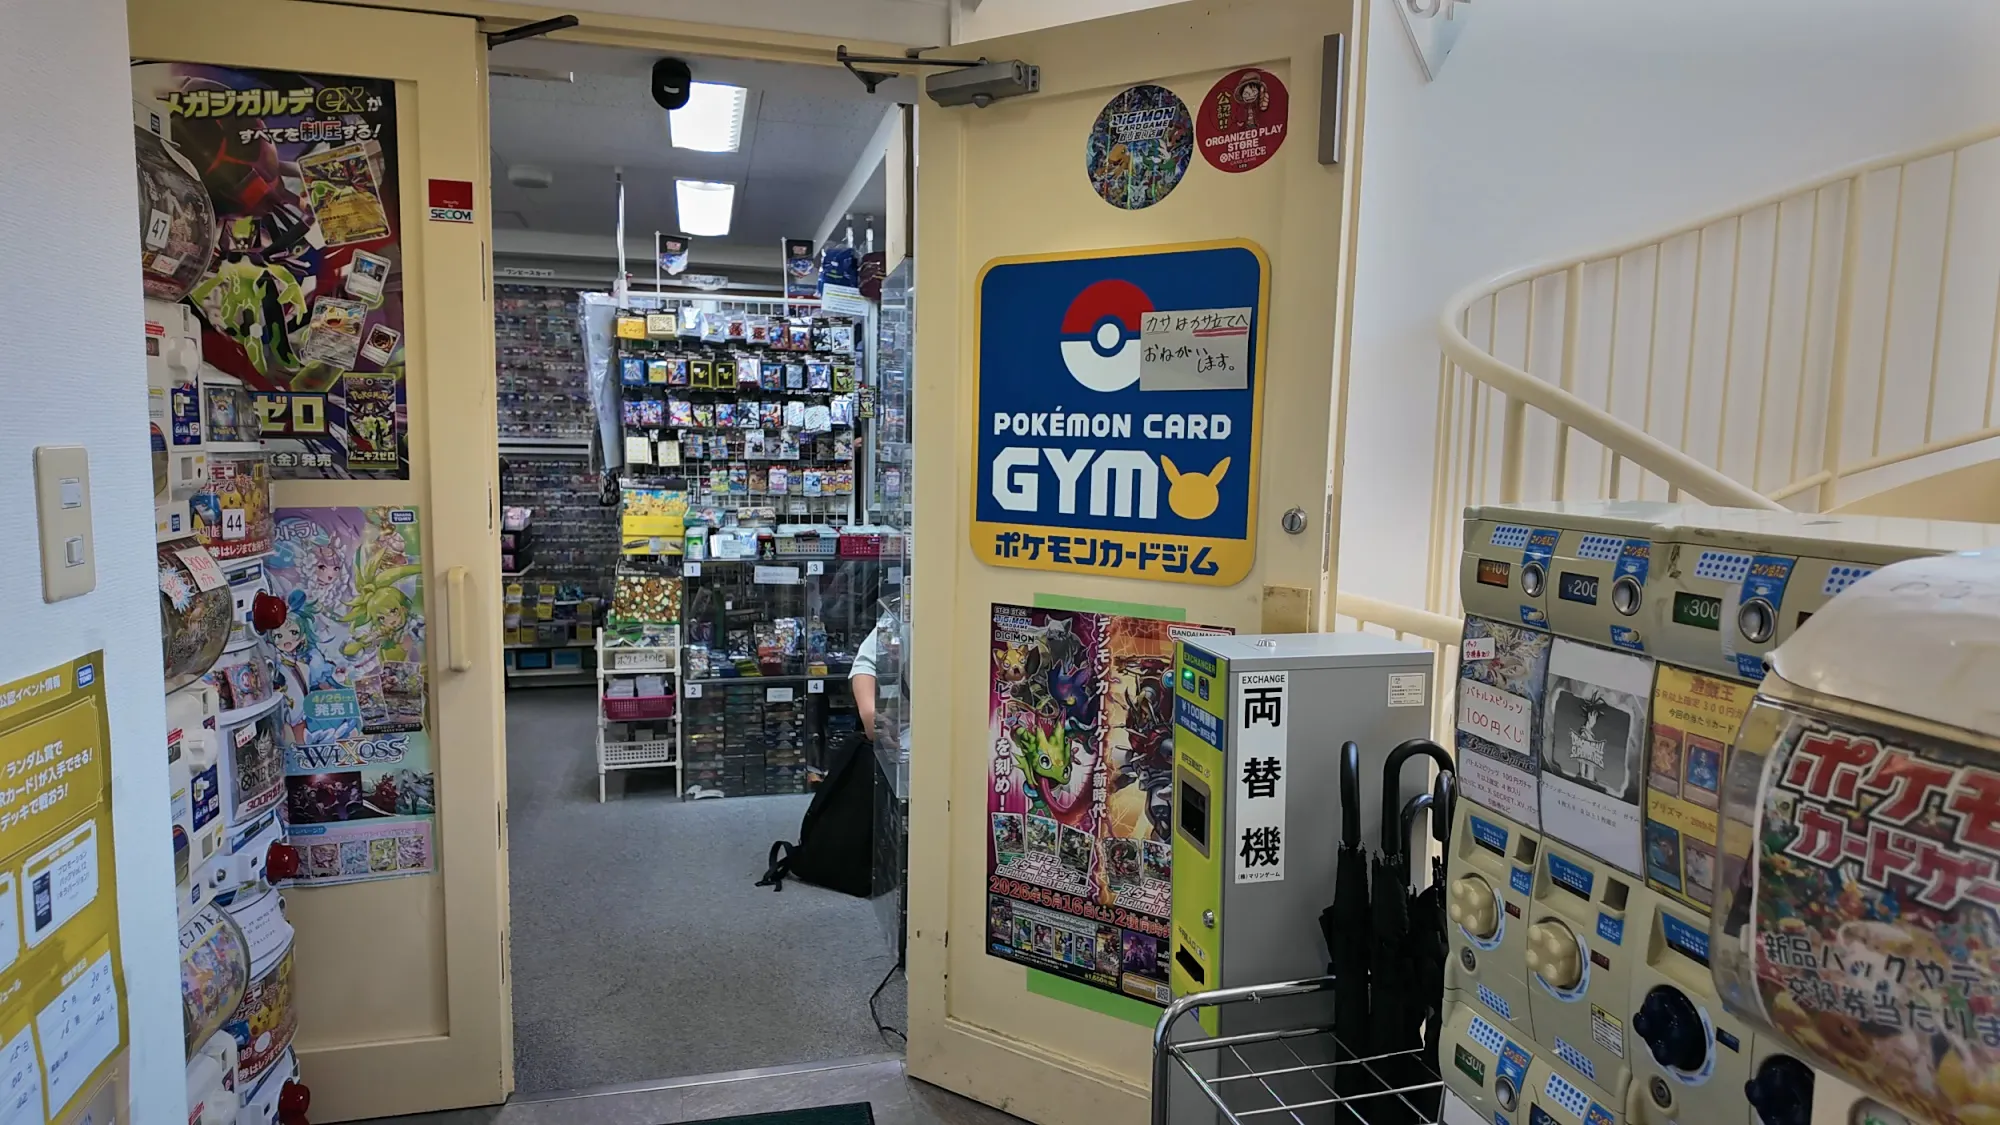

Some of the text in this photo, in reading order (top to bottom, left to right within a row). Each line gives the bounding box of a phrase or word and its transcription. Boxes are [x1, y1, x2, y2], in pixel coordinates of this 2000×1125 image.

[1111, 108, 1175, 126] DIGIMON
[1205, 124, 1283, 148] ORGANIZED PLAY
[1227, 138, 1259, 152] STORE
[1220, 146, 1267, 164] ONE PIECE
[431, 209, 471, 220] SECOM
[152, 218, 167, 240] 47
[1144, 344, 1209, 363] おねがい
[1197, 353, 1236, 374] します。
[253, 395, 325, 433] ゼロ
[994, 405, 1232, 440] POKÉMON CARD
[992, 447, 1159, 519] GYM
[226, 514, 242, 531] 44
[995, 531, 1219, 576] ポケモンカードジム
[690, 566, 695, 574] 1
[1683, 599, 1720, 620] ¥300
[993, 615, 1032, 626] DIGIMON
[995, 630, 1035, 643] DIGIMON
[812, 683, 819, 691] 4
[1241, 675, 1286, 685] EXCHANGE
[690, 687, 697, 695] 2
[1466, 686, 1524, 715] バトルスピリッツ
[315, 702, 354, 717] 発売!
[1467, 707, 1526, 743] 100円くじ
[294, 738, 404, 768] WIXOSS
[1239, 686, 1284, 868] 両替機
[1029, 851, 1060, 867] ST-23
[1010, 858, 1080, 884] スタートデッキ
[995, 865, 1089, 897] DIGIMON BEATBREAK
[1116, 897, 1161, 915] DIGIMON
